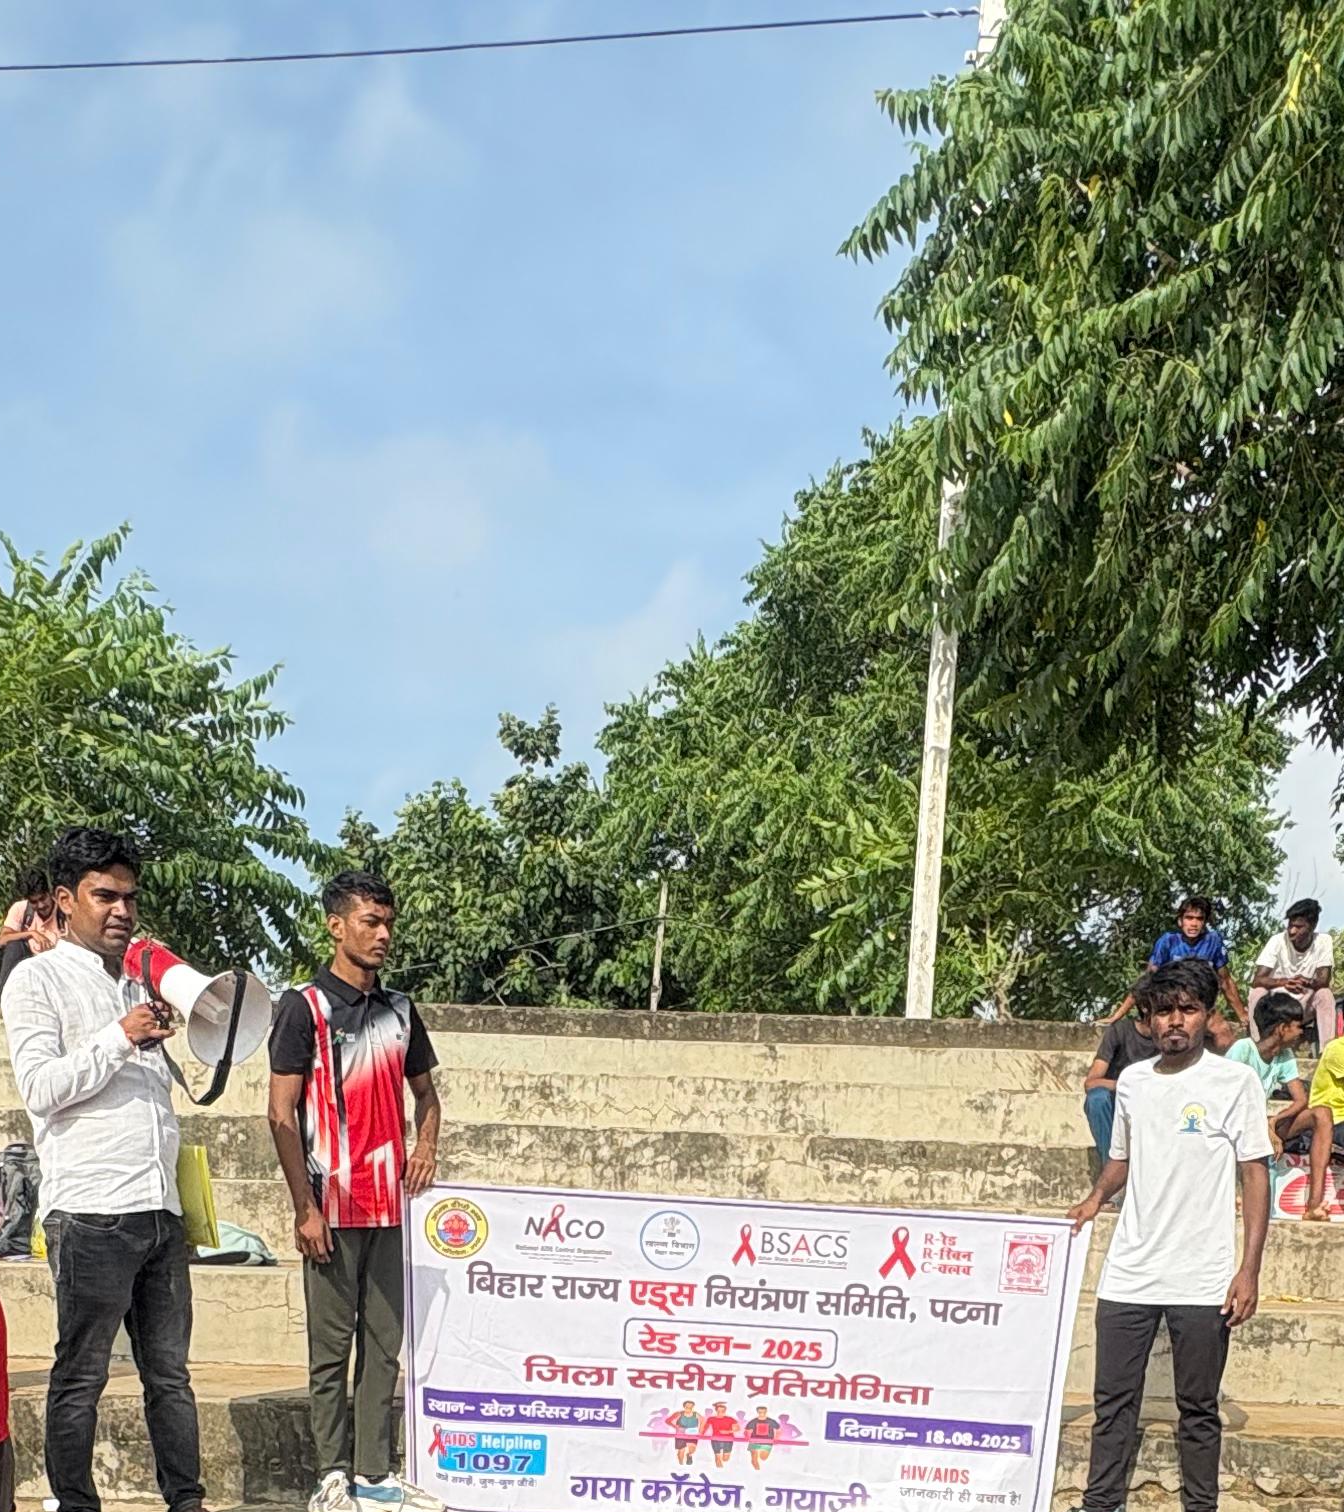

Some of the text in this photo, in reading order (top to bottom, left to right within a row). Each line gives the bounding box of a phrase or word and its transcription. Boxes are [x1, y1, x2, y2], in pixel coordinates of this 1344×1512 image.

[524, 1204, 605, 1243] NACO
[761, 1231, 848, 1258] BSACS
[466, 1260, 1003, 1326] बिहार राज्य एड्स नियंत्रण समिति, पटना
[638, 1323, 680, 1355] रेड
[761, 1338, 823, 1361] 2025
[523, 1354, 934, 1405] जिला स्तरीय प्रतियोगिता
[479, 1398, 516, 1418] खेल
[573, 1404, 619, 1423] ग्राउंड
[443, 1431, 542, 1453] AIDS Helpline
[924, 1429, 1022, 1450] 18.08.2025
[453, 1451, 532, 1472] 1097
[899, 1464, 970, 1485] HIV/AIDS
[570, 1475, 635, 1501] गया
[899, 1486, 954, 1501] जानकारी
[957, 1487, 971, 1503] ही
